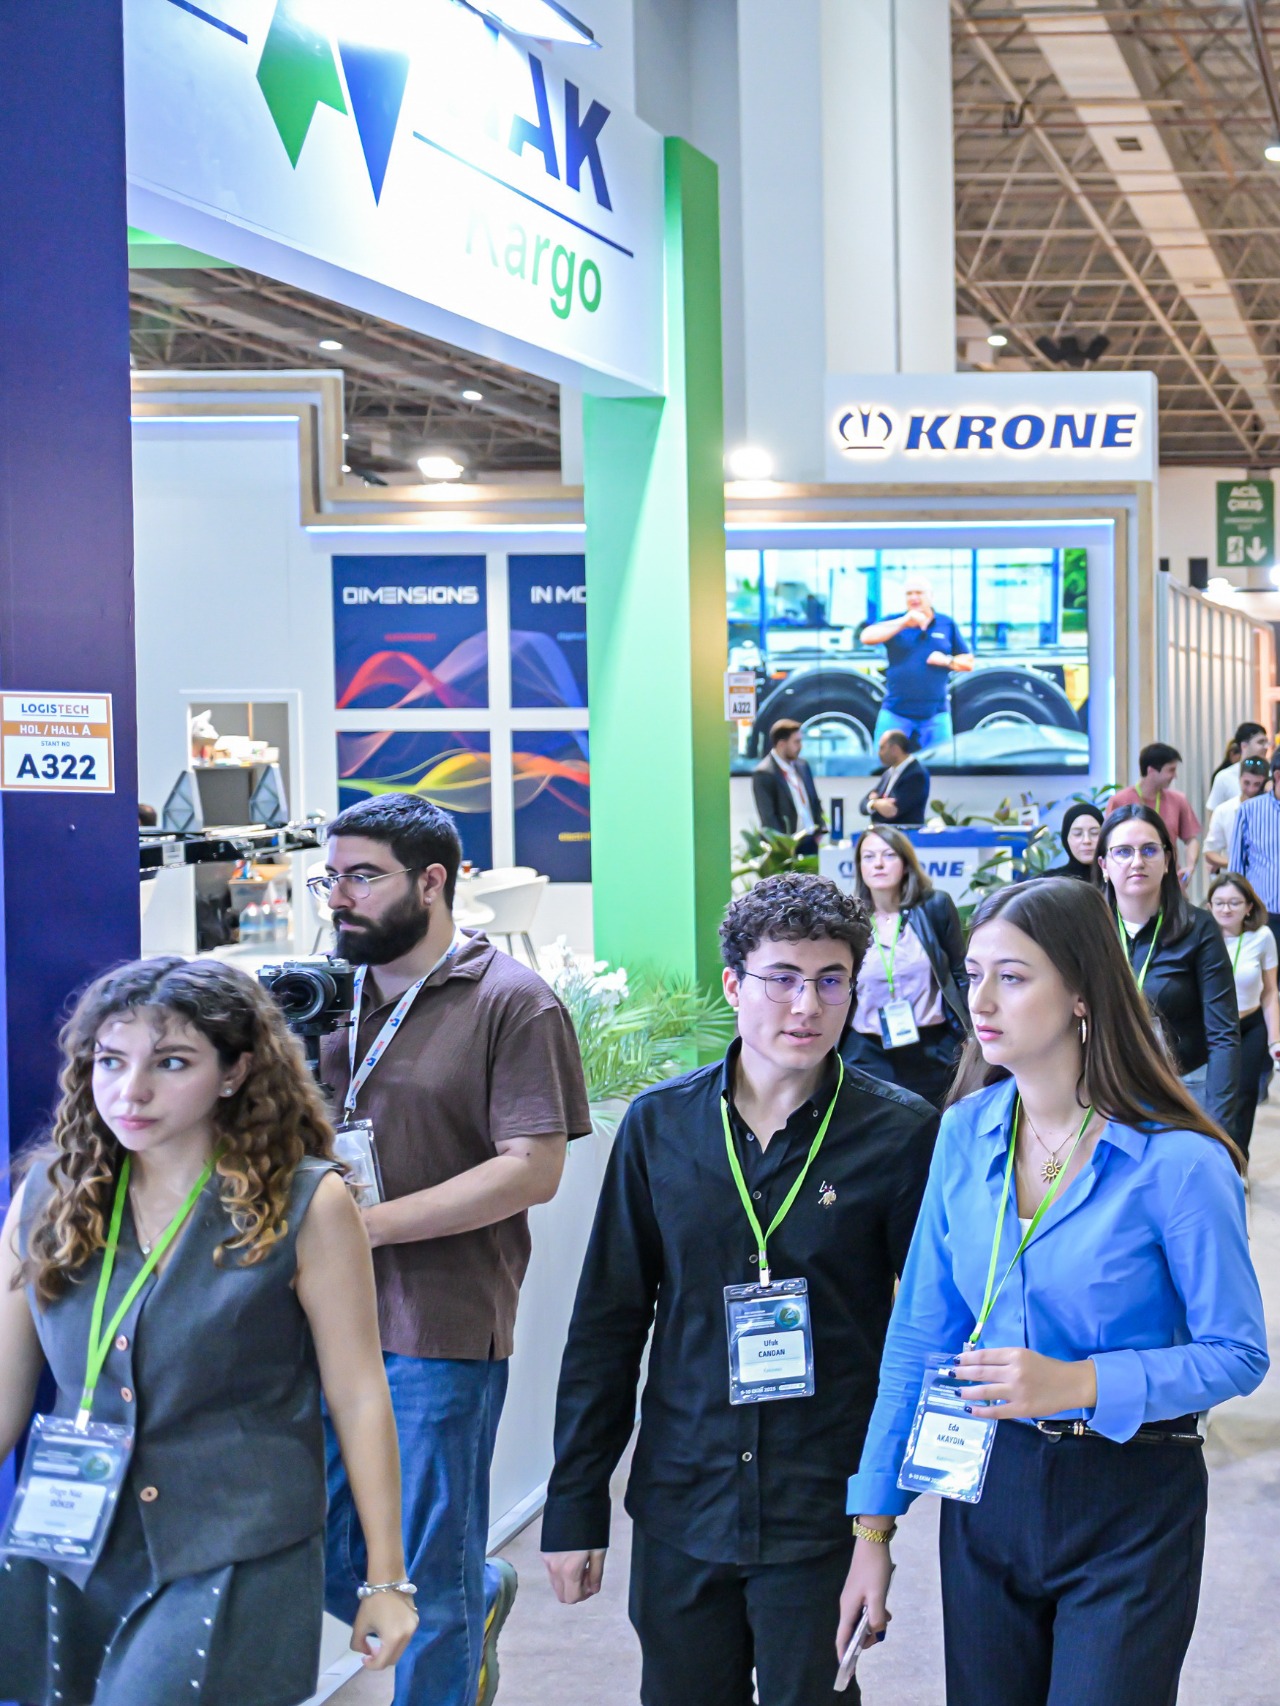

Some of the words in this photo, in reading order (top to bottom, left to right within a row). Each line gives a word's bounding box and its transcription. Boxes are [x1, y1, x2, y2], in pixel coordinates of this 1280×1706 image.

[905, 413, 1137, 450] KRONE
[342, 586, 480, 604] DIMENSIONS
[530, 586, 552, 604] IN
[21, 703, 89, 714] LOGISTECH
[20, 724, 41, 734] HOL
[51, 725, 79, 735] HALL
[82, 724, 91, 736] A
[16, 753, 96, 780] A322
[764, 1339, 779, 1347] Ufuk
[948, 1423, 960, 1432] Eda
